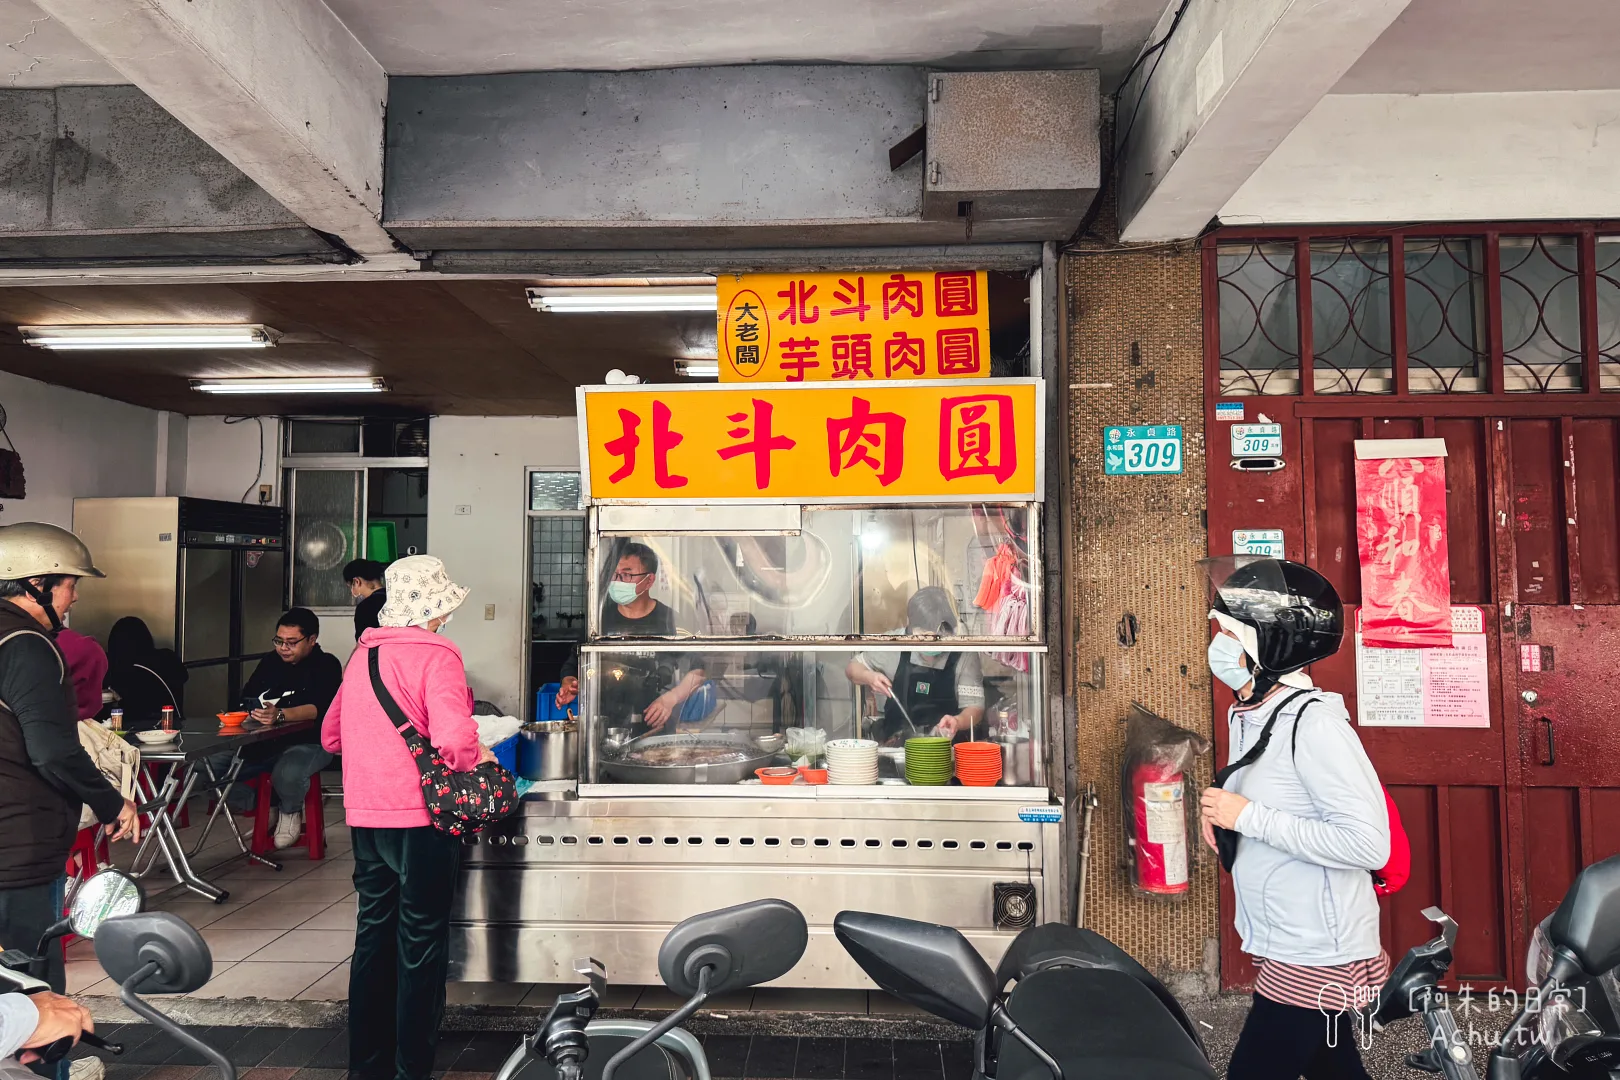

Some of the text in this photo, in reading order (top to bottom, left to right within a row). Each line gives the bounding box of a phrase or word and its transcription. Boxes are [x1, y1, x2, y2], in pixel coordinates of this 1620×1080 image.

[777, 270, 978, 326] 北斗肉圓
[734, 302, 760, 366] 大老闆
[778, 326, 980, 382] 芋頭肉圓
[604, 393, 1018, 490] 北斗肉圓
[1126, 427, 1177, 437] 永貞路
[1243, 439, 1269, 452] 309
[1128, 442, 1177, 468] 309
[1246, 545, 1272, 556] 309
